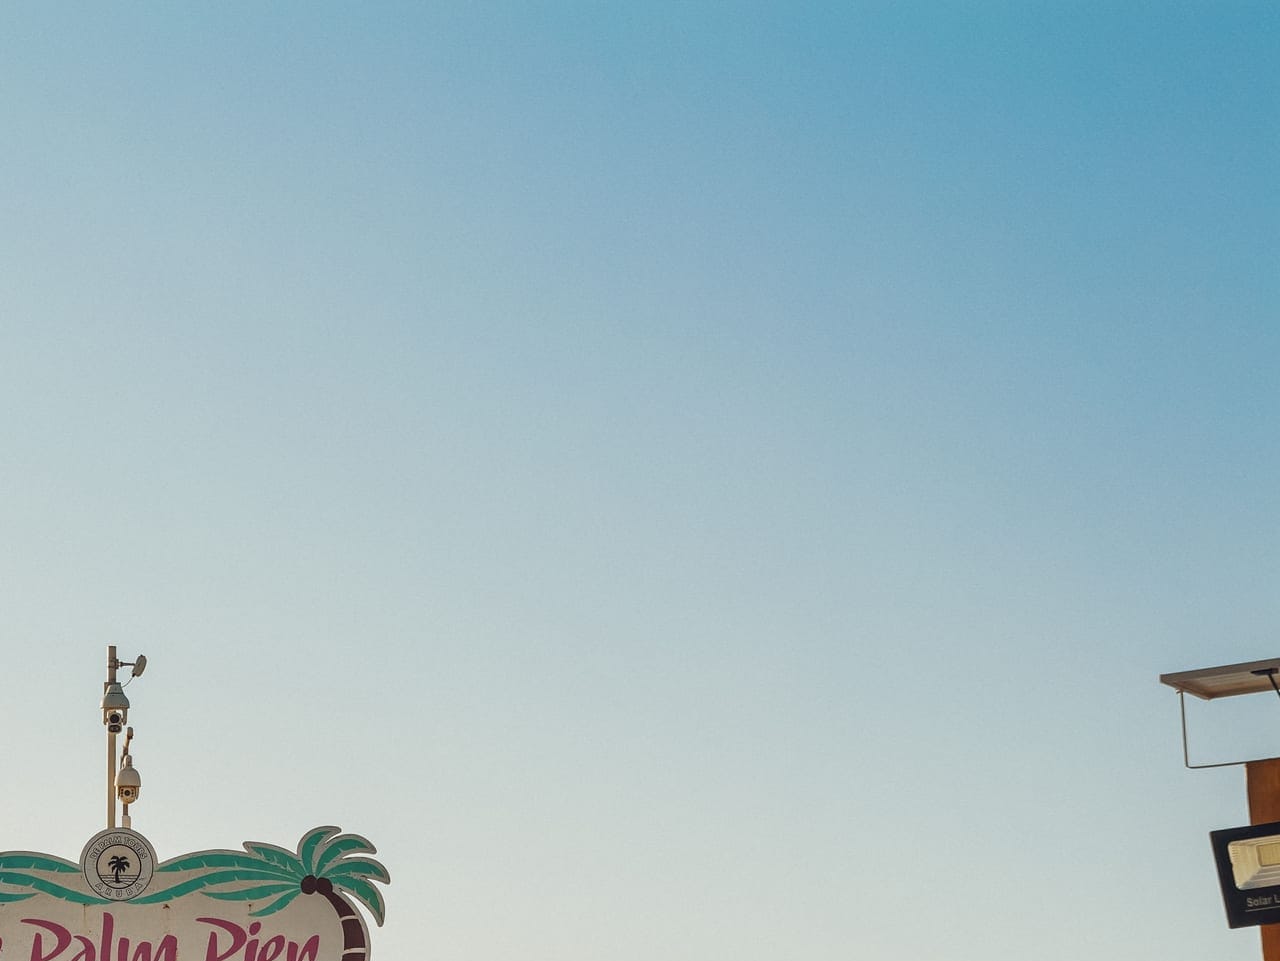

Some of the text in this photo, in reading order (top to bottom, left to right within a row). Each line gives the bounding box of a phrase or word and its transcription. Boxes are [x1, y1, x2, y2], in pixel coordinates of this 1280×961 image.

[89, 835, 148, 860] DE PALM TOURS
[94, 881, 144, 898] ARUBA
[1246, 895, 1273, 908] Solar
